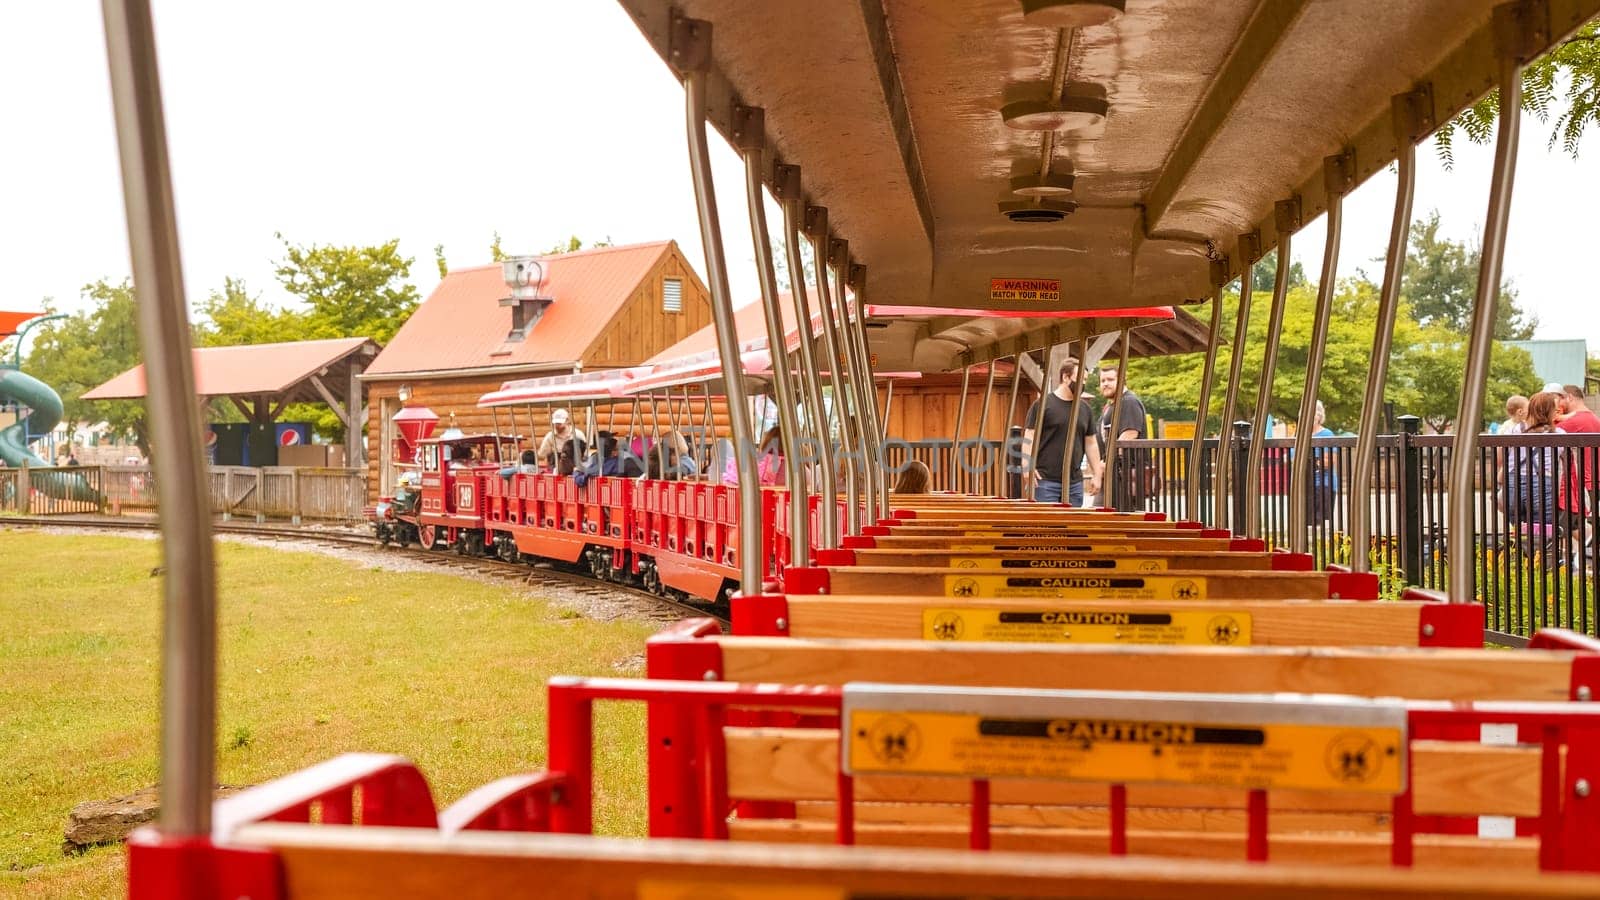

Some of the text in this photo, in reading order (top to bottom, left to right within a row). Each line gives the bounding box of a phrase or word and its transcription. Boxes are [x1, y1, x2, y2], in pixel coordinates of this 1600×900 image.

[1004, 281, 1058, 290] WARNING
[1030, 560, 1088, 568] CAUTION
[1040, 578, 1111, 588] CAUTION
[1041, 612, 1130, 624] CAUTION
[1047, 719, 1195, 743] CAUTION
